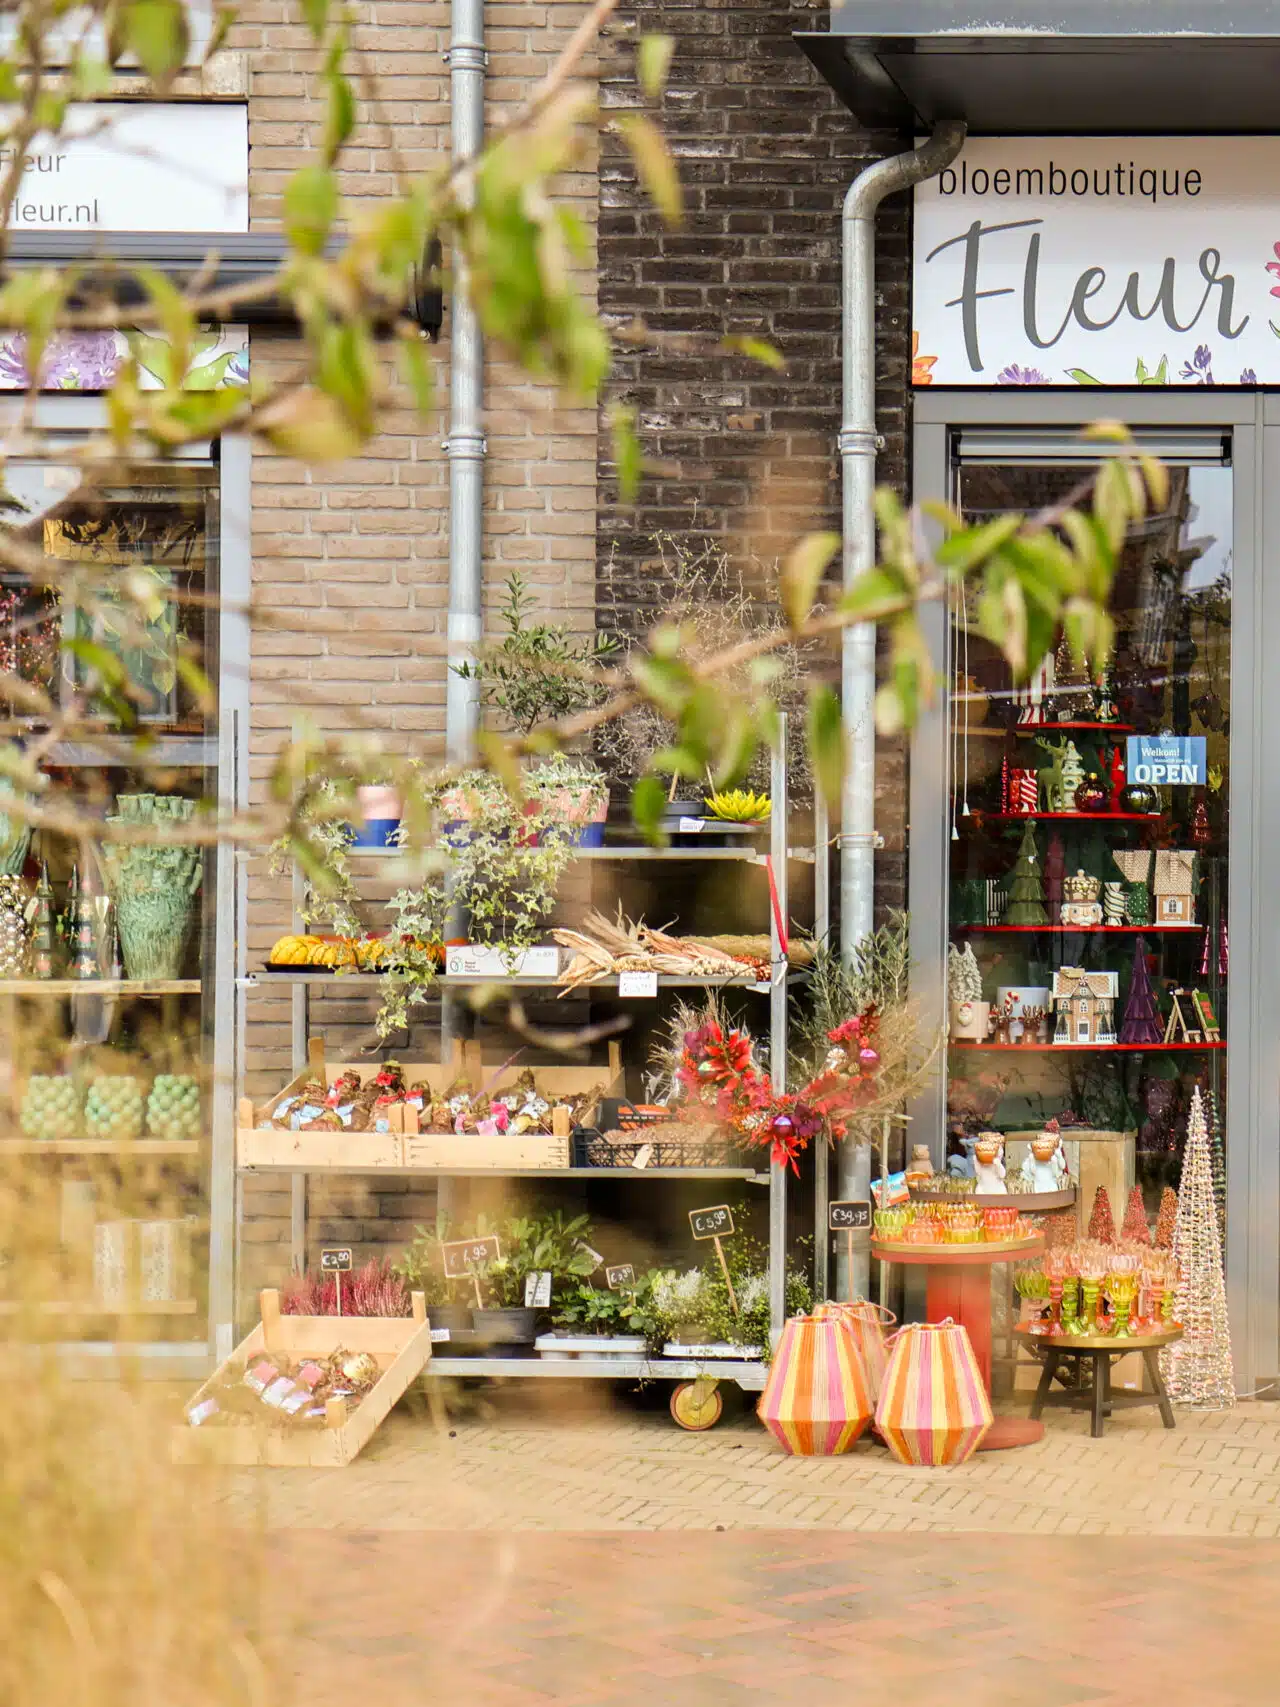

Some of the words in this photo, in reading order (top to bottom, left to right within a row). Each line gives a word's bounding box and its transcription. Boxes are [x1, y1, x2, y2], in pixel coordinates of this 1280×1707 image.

[938, 161, 1202, 204] bloemboutique
[926, 218, 1249, 373] Fleur
[1141, 747, 1180, 758] Welkom!
[1134, 764, 1199, 784] OPEN
